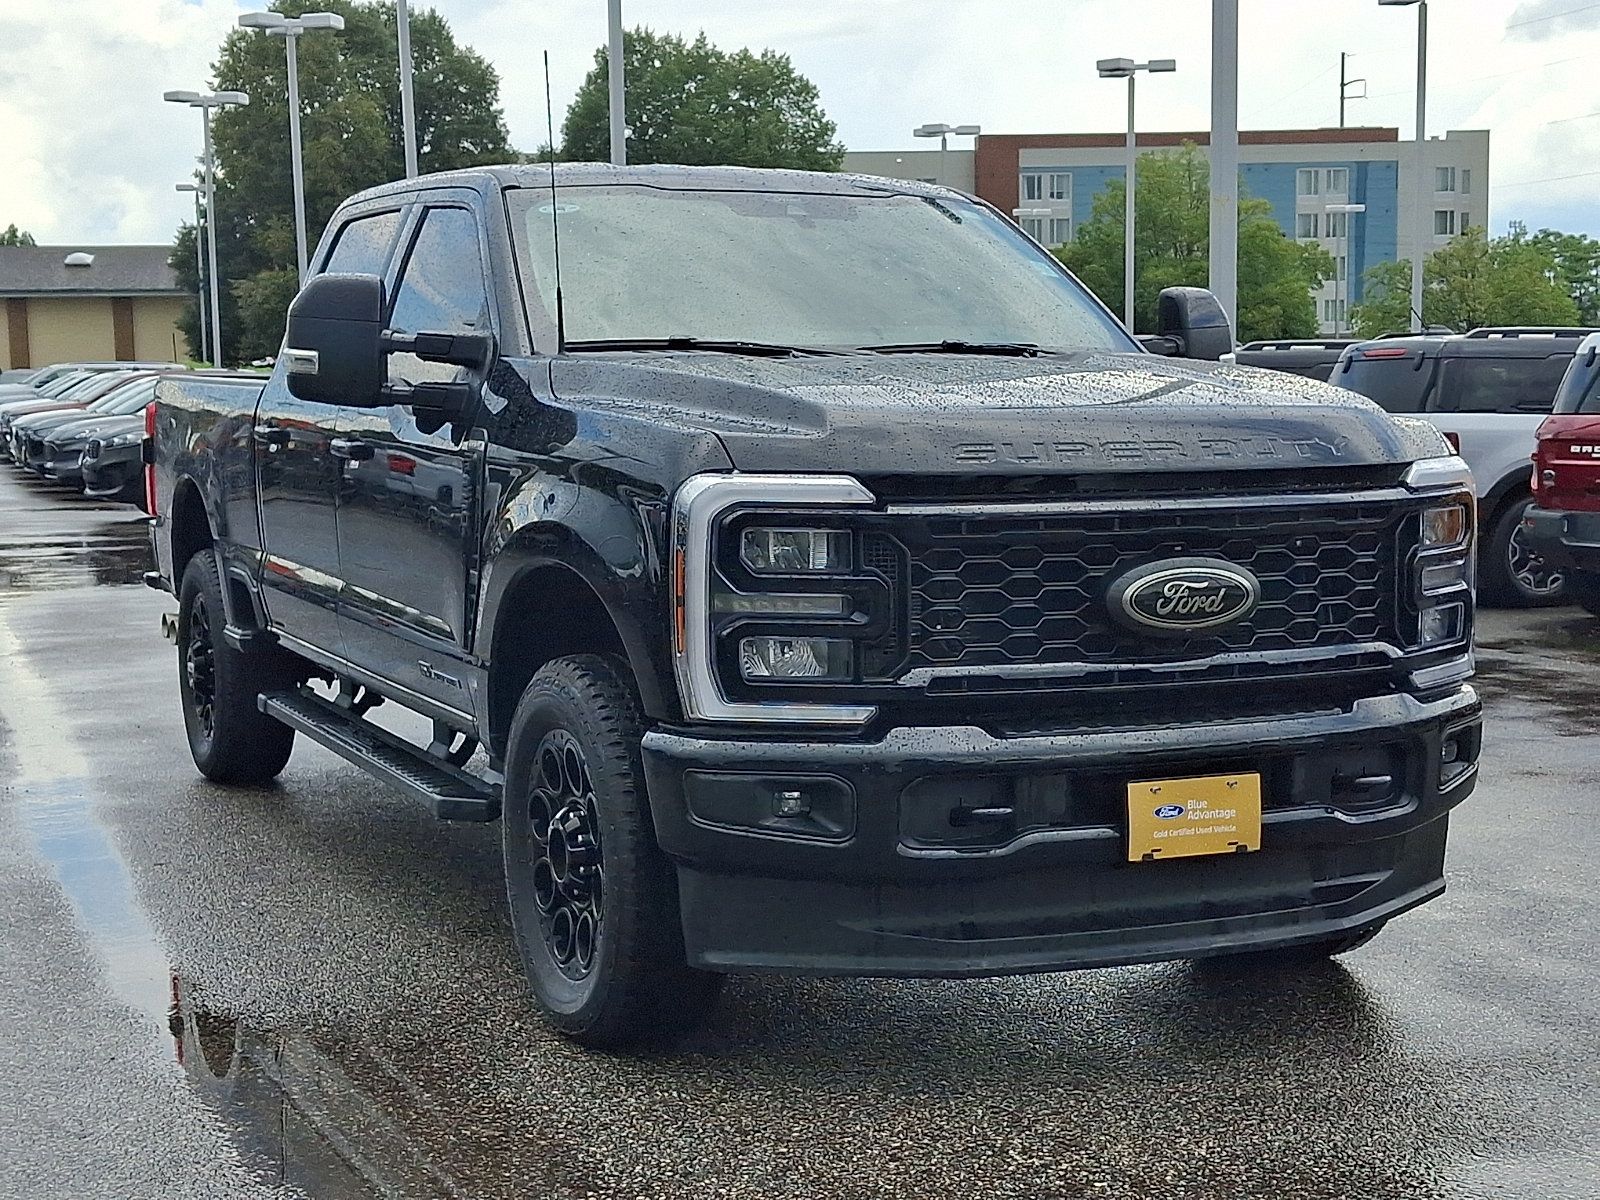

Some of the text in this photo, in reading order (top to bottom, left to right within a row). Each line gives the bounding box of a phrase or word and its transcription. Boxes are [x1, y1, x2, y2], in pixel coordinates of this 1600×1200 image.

[952, 436, 1348, 464] SUPER DUTY
[1156, 580, 1227, 616] Ford
[1187, 799, 1208, 810] Blue
[1187, 808, 1237, 821] Advantage
[1153, 824, 1237, 839] Gold Certified Used Vehicle
